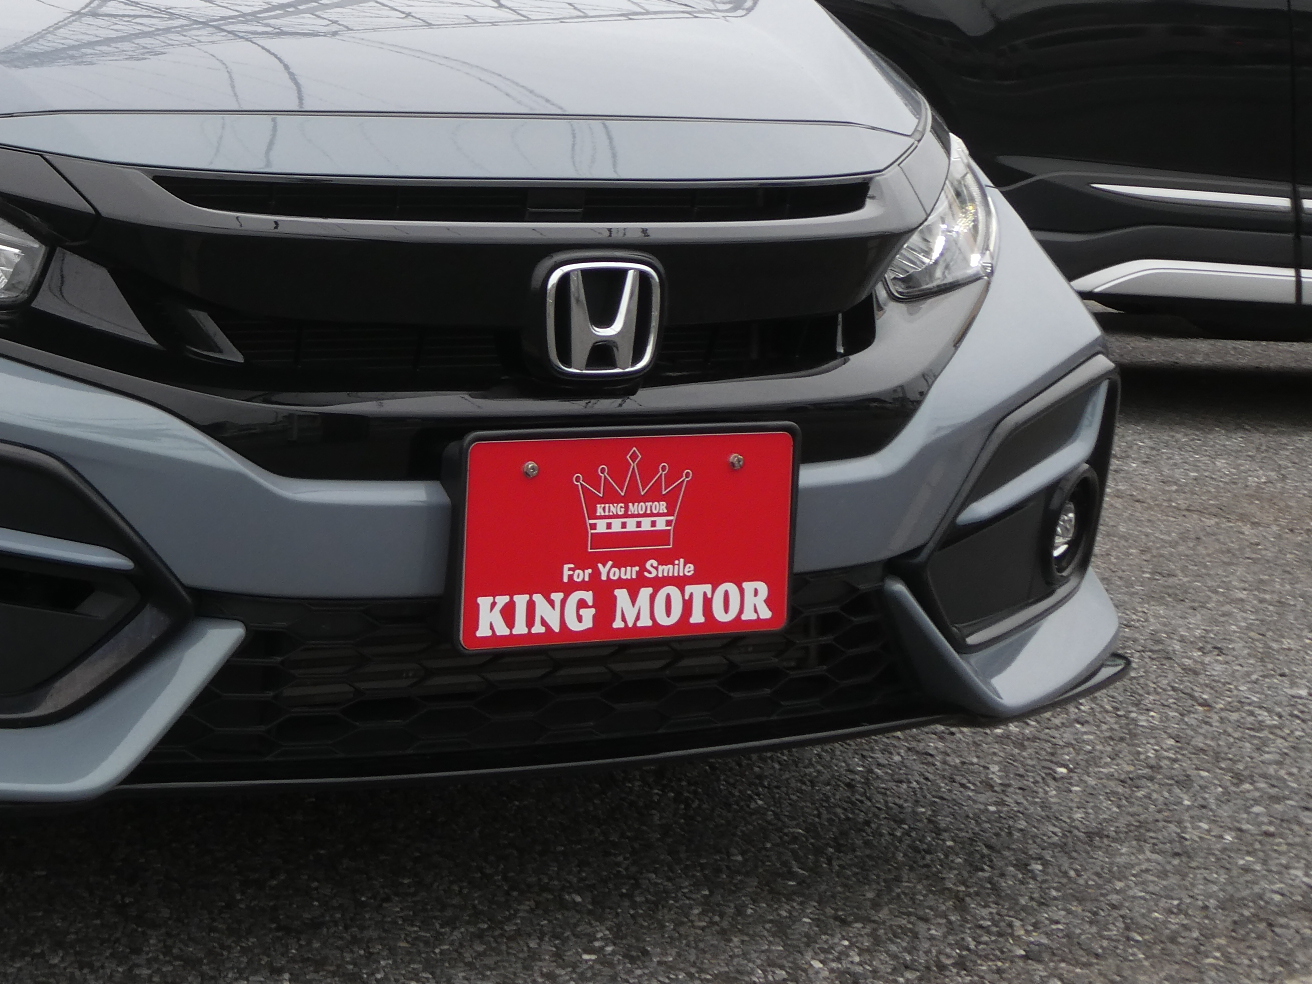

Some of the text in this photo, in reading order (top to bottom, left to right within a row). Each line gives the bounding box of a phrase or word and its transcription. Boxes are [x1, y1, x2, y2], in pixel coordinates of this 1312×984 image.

[596, 501, 668, 516] KING MOTOR
[562, 558, 695, 583] For Your Smile
[475, 580, 772, 637] KING MOTOR
